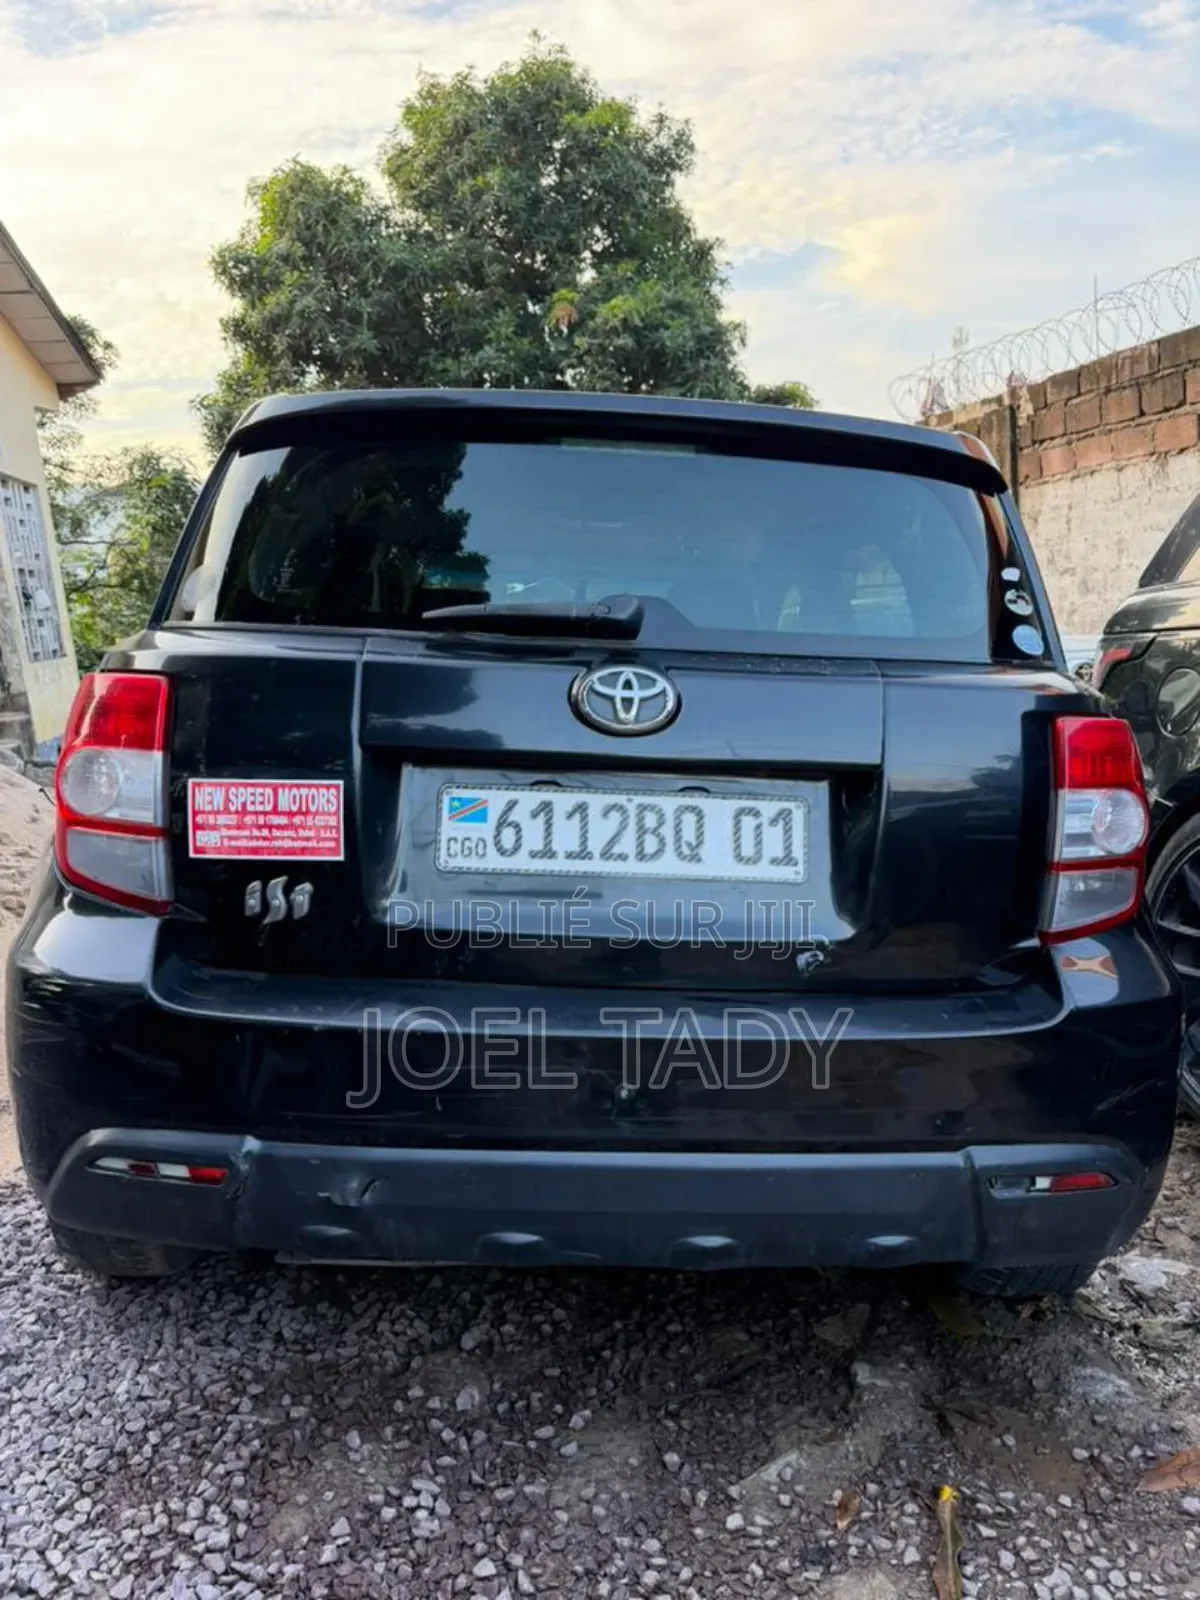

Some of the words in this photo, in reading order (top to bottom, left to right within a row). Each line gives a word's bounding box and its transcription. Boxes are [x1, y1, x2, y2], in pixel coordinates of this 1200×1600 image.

[195, 787, 225, 811] NEW
[228, 787, 274, 812] SPEED
[277, 788, 338, 812] MOTORS
[493, 799, 705, 864] 6112BQ
[732, 805, 799, 867] 01
[446, 836, 488, 859] CGO
